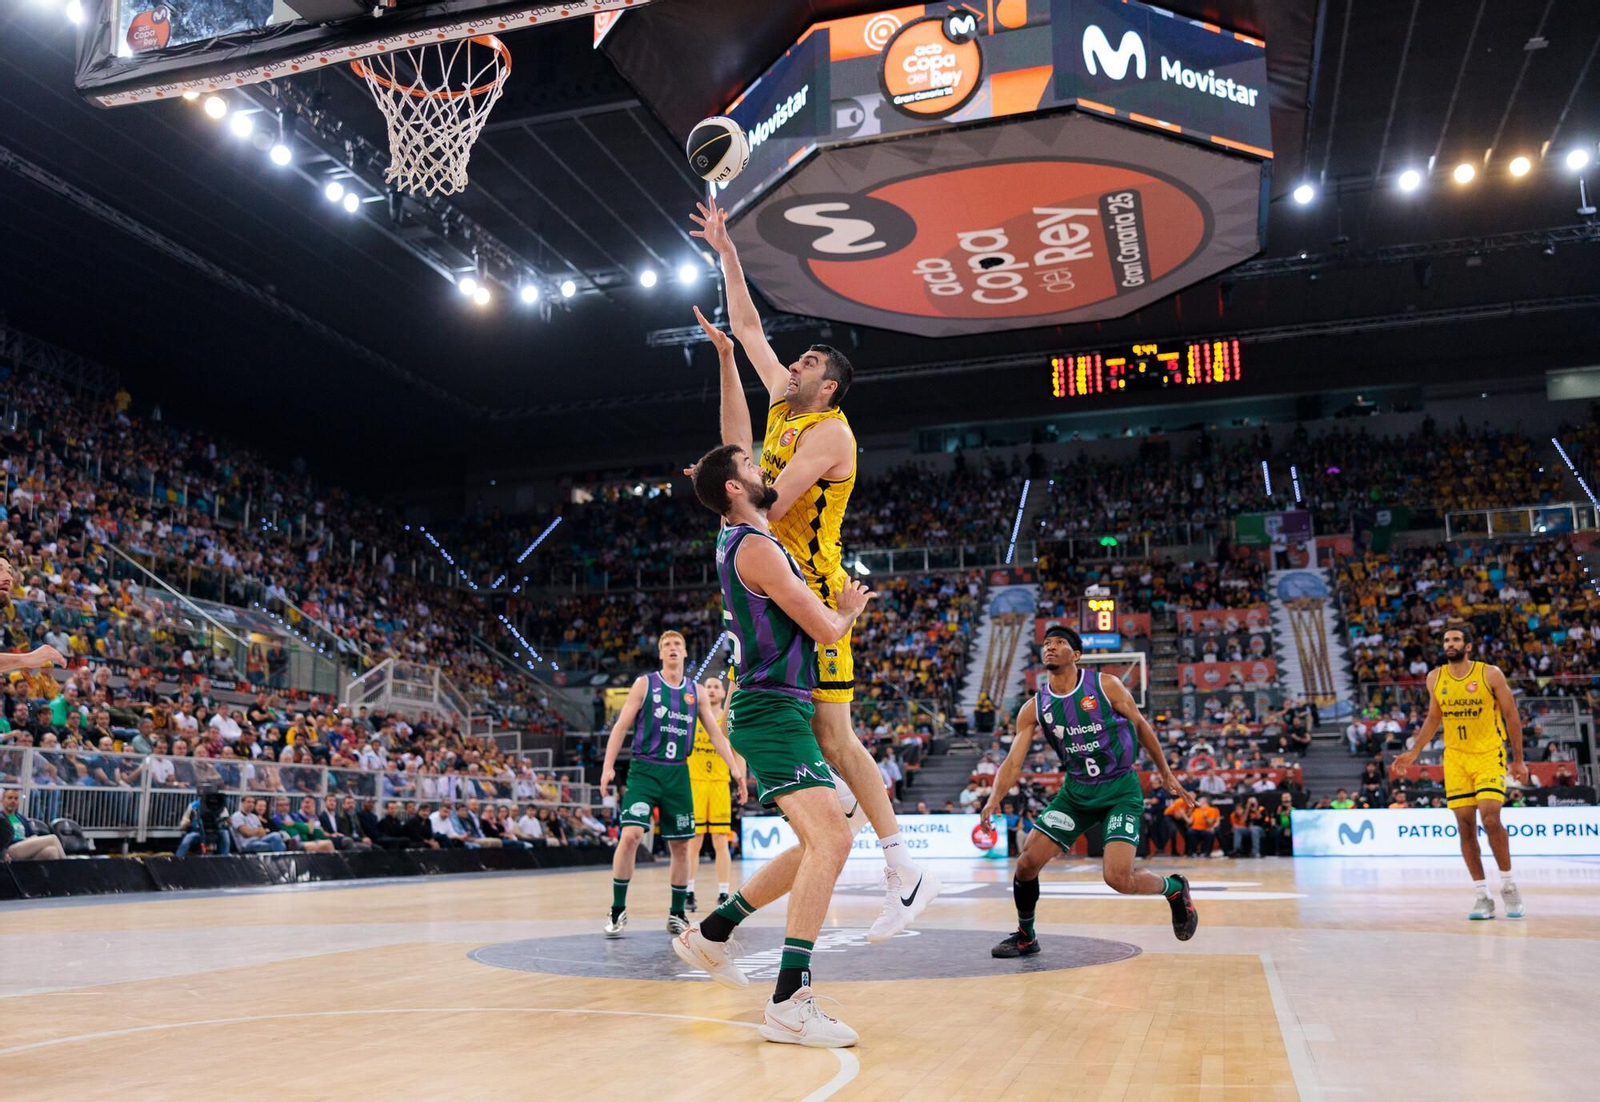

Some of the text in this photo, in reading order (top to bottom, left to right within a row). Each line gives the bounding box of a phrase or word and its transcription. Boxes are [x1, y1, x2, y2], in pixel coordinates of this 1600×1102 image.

[134, 30, 155, 40] Copa
[143, 38, 158, 46] Rey
[902, 53, 956, 73] Copa
[930, 69, 963, 88] Rey
[1160, 55, 1259, 107] Movistar
[893, 94, 915, 105] Gran
[749, 84, 809, 153] Movistar
[1109, 215, 1142, 263] Canaria
[1032, 207, 1098, 293] del Rey
[957, 227, 1030, 304] Copa
[1121, 261, 1145, 288] Gran
[912, 257, 964, 296] acb
[1098, 611, 1111, 631] 8
[1448, 698, 1483, 706] LAGUNA
[667, 711, 693, 724] Unicaja
[1066, 723, 1103, 736] Unicaja
[1457, 725, 1468, 740] 11
[665, 741, 677, 759] 9
[706, 761, 712, 773] 9
[1085, 758, 1101, 777] 6
[898, 824, 952, 834] RINCIPAL
[1398, 823, 1599, 837] PATRONDOR PRIN
[905, 839, 929, 849] 025
